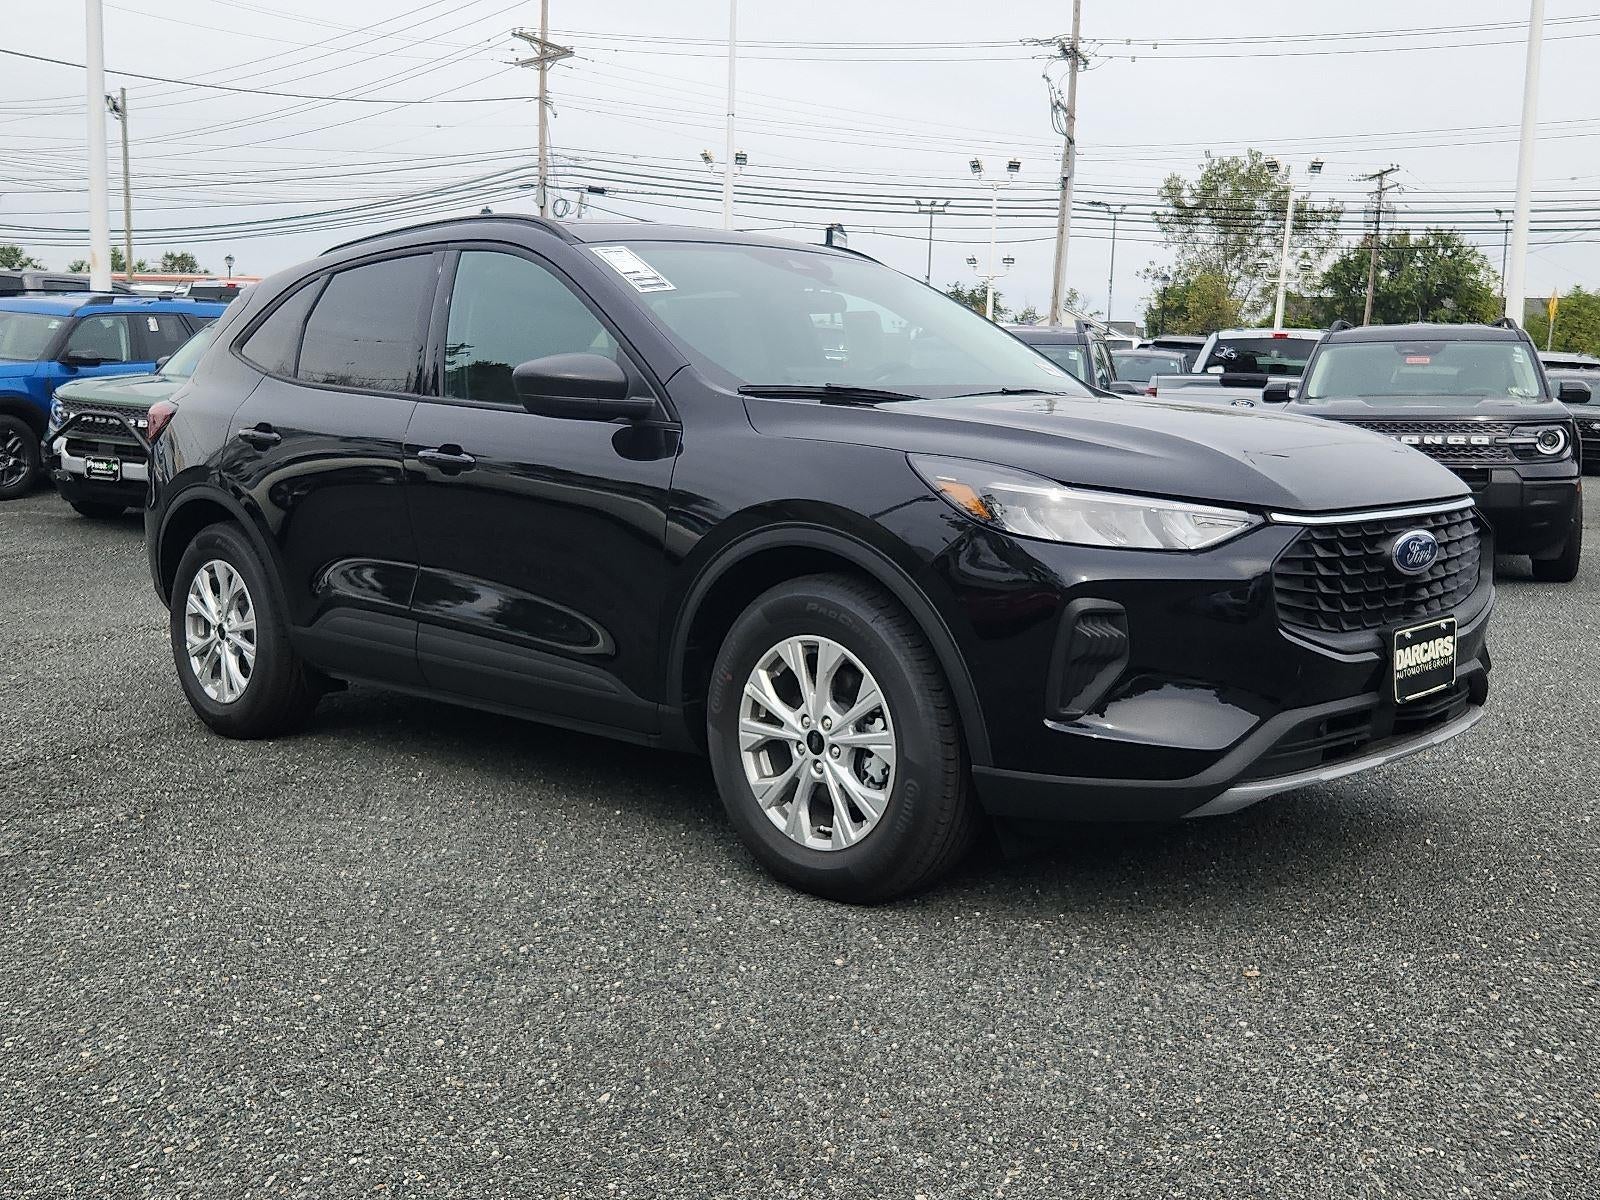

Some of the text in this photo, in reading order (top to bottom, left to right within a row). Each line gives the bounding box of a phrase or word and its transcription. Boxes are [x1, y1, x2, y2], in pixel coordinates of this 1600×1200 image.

[1391, 435, 1490, 445] ONCO
[1406, 540, 1432, 565] Ford
[1396, 635, 1454, 671] DARCARS
[1396, 655, 1454, 680] AUTOMOTIVE GROUP
